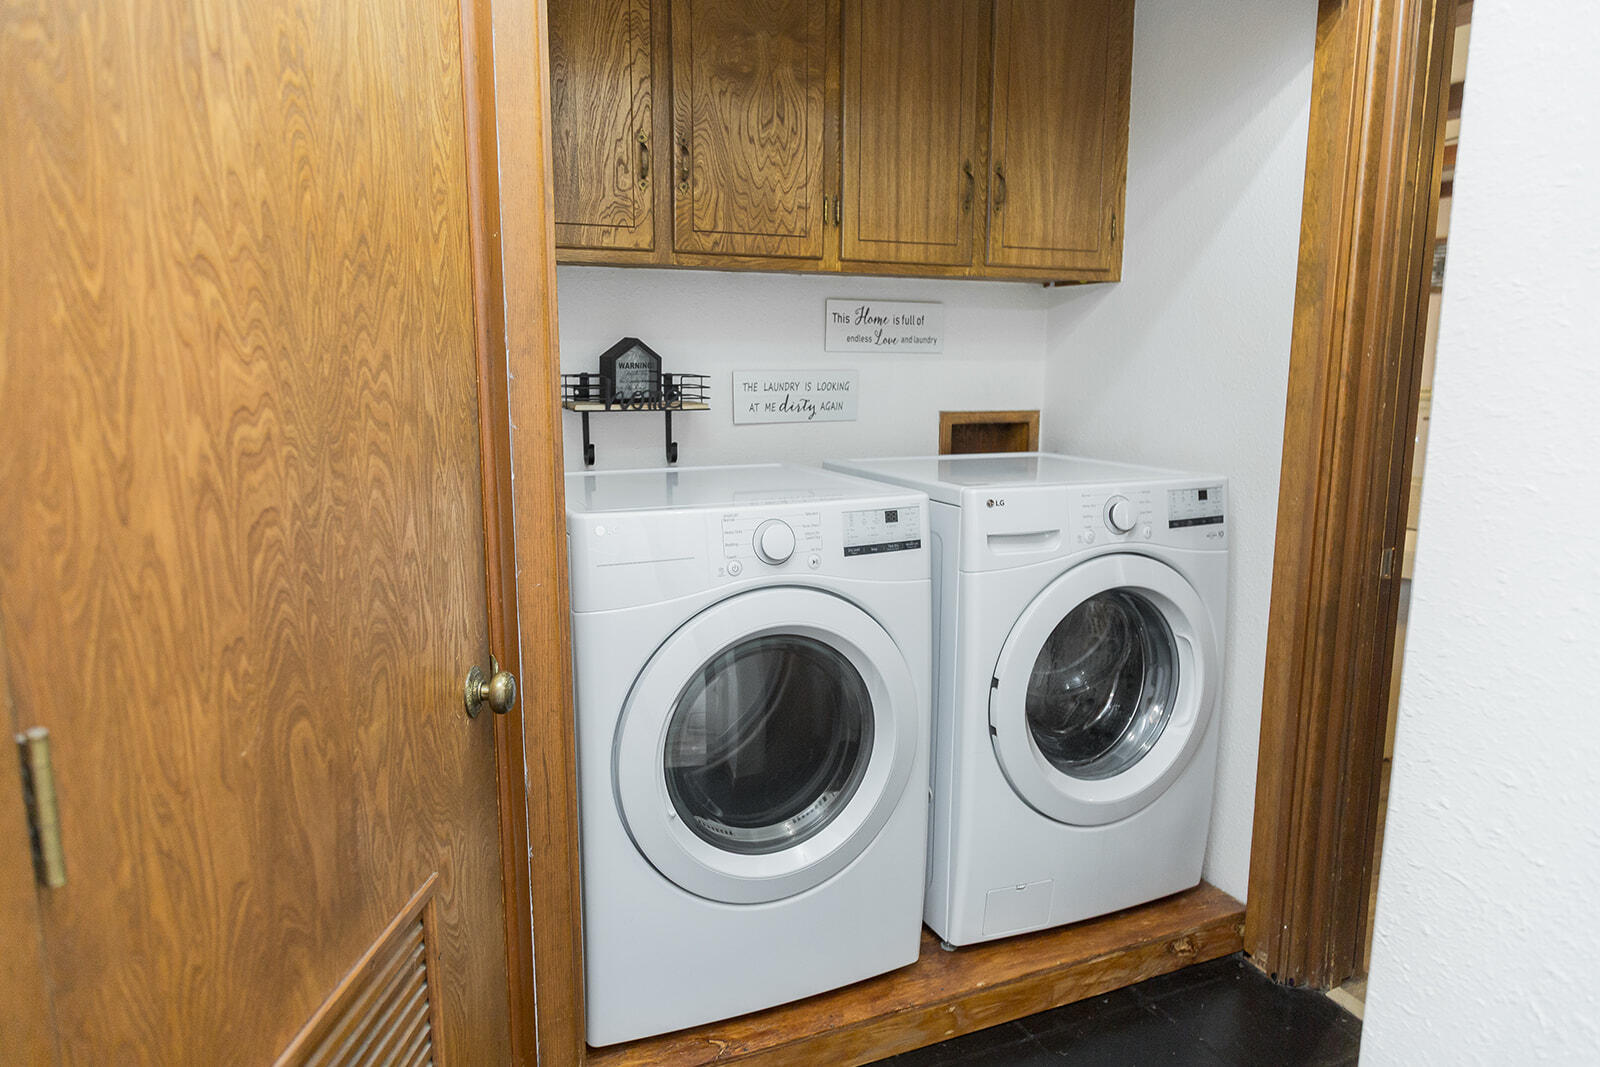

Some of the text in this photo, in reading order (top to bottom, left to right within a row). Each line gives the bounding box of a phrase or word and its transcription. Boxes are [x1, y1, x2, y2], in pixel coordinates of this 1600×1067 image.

[832, 305, 925, 326] This Home is full of
[846, 328, 938, 345] endless Love and laundry
[743, 381, 850, 392] THE LAUNDRY IS LOOKING
[749, 393, 844, 420] AT ME dirty AGAIN
